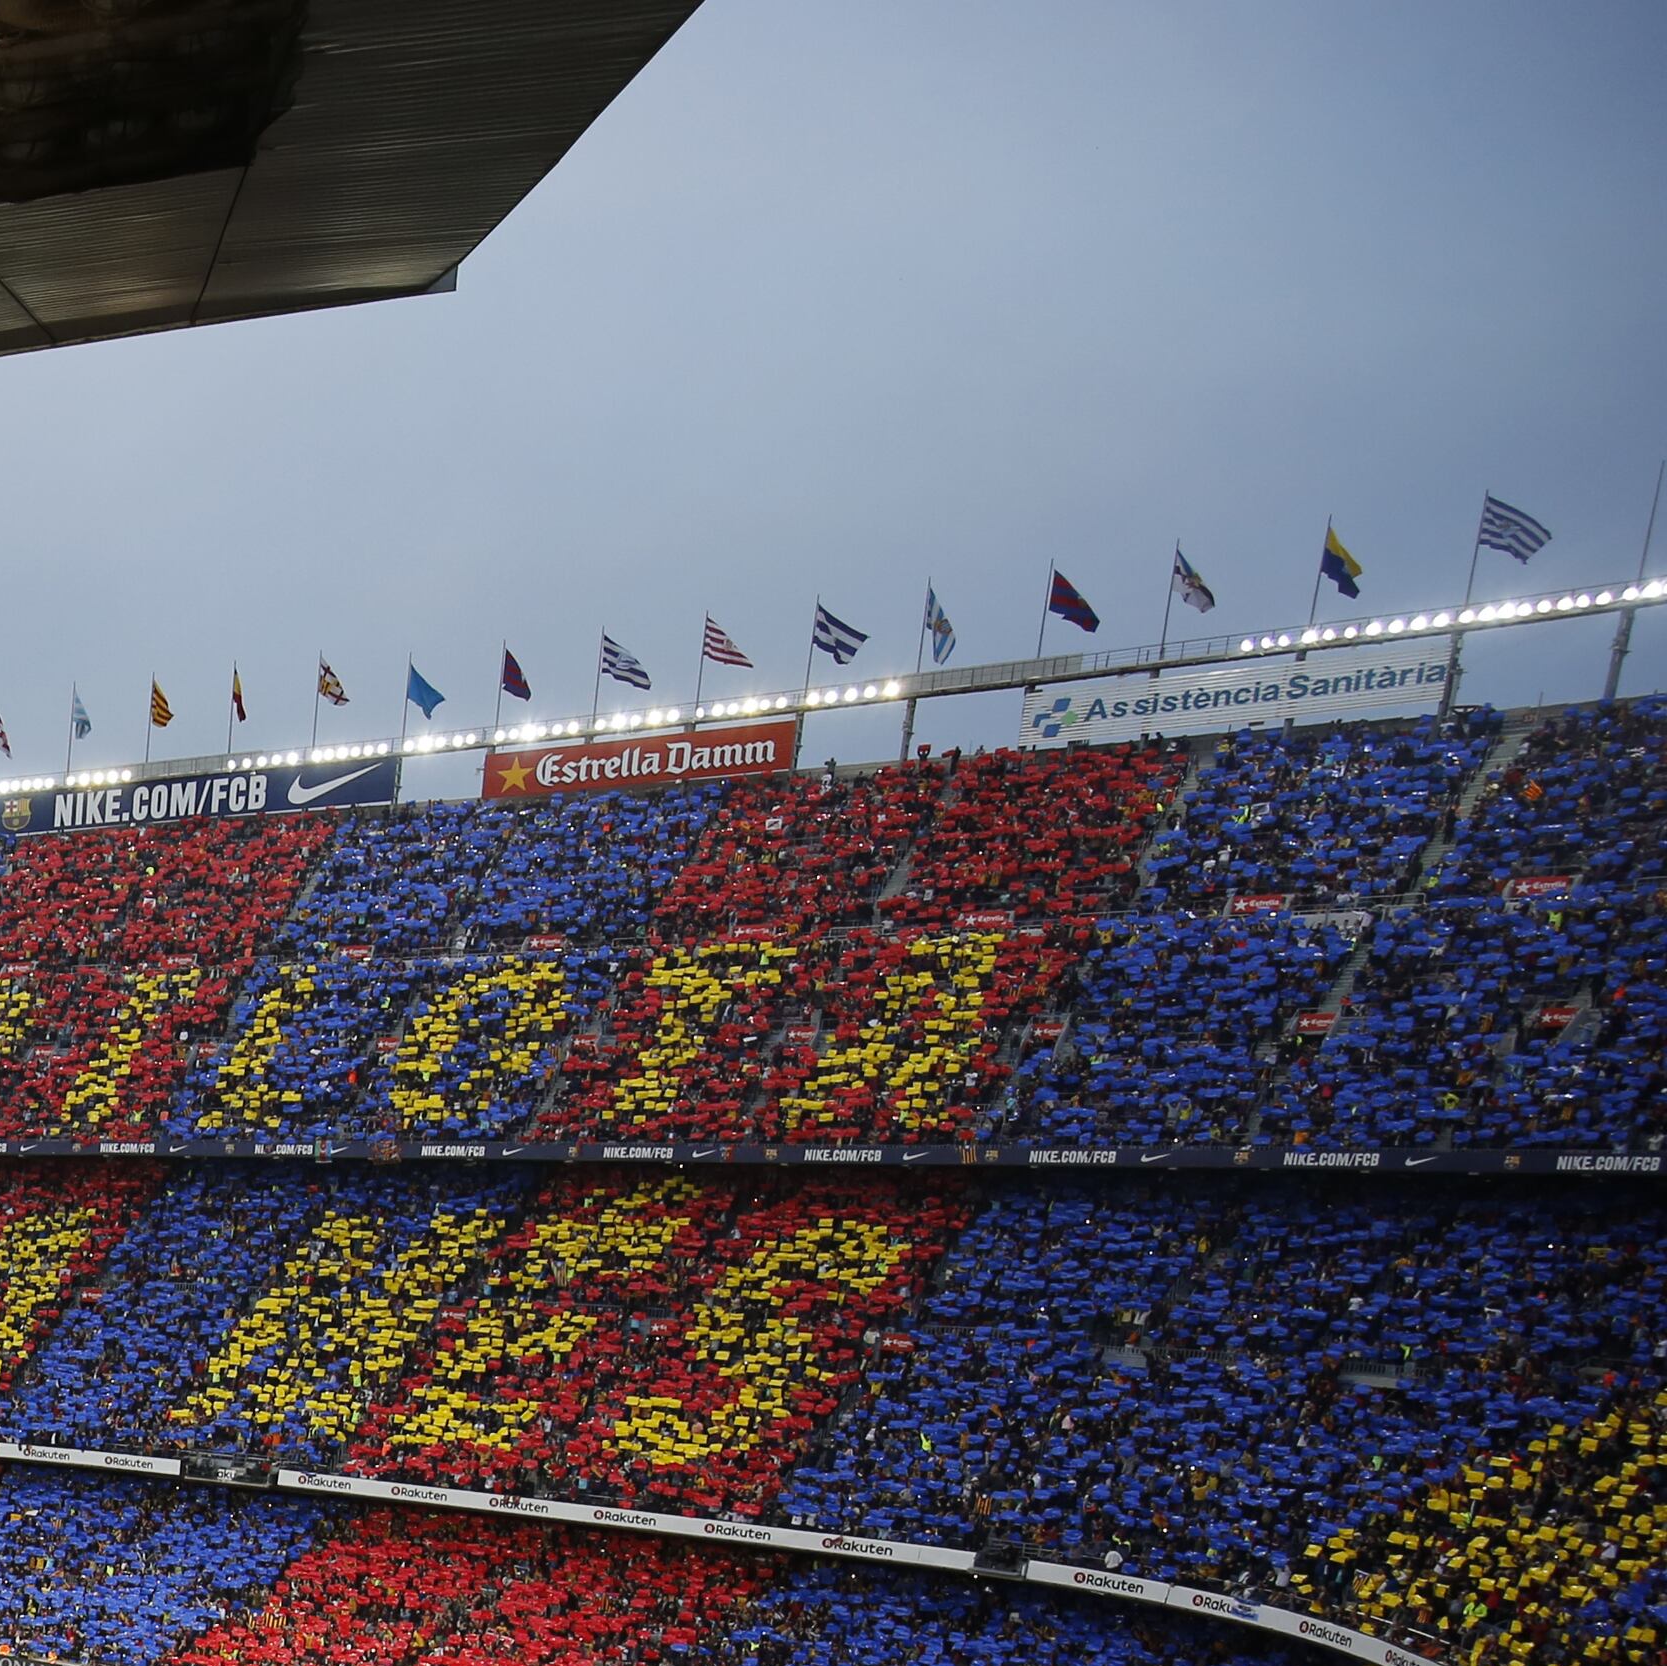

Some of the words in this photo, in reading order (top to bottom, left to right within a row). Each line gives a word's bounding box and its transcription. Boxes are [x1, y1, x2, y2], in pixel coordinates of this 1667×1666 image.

[1084, 682, 1280, 722] Assistència
[1286, 661, 1447, 700] Sanitària
[536, 746, 660, 787] Estrella
[664, 740, 776, 775] Damm
[54, 775, 267, 828] NIKE.COM/FCB
[99, 1143, 156, 1155] NIKE.COM/FCB
[421, 1144, 486, 1158] NIKE.COM/FCB
[602, 1146, 674, 1160] NIKE.COM/FCB
[804, 1149, 882, 1163] NIKE.COM/FCB
[1028, 1150, 1117, 1165] NIKE.COM/FCB
[1283, 1151, 1380, 1168] NIKE.COM/FCB
[1556, 1155, 1661, 1173] NIKE.COM/FCB
[30, 1445, 71, 1461] Rakuten
[115, 1454, 155, 1471] Rakuten
[308, 1473, 352, 1491] Rakuten
[400, 1485, 449, 1503] Rakuten
[603, 1509, 658, 1529] Rakuten
[714, 1523, 772, 1544] Rakuten
[1084, 1574, 1145, 1597] Rakuten
[1203, 1595, 1233, 1613] Raku
[1309, 1622, 1353, 1650] Rakuten
